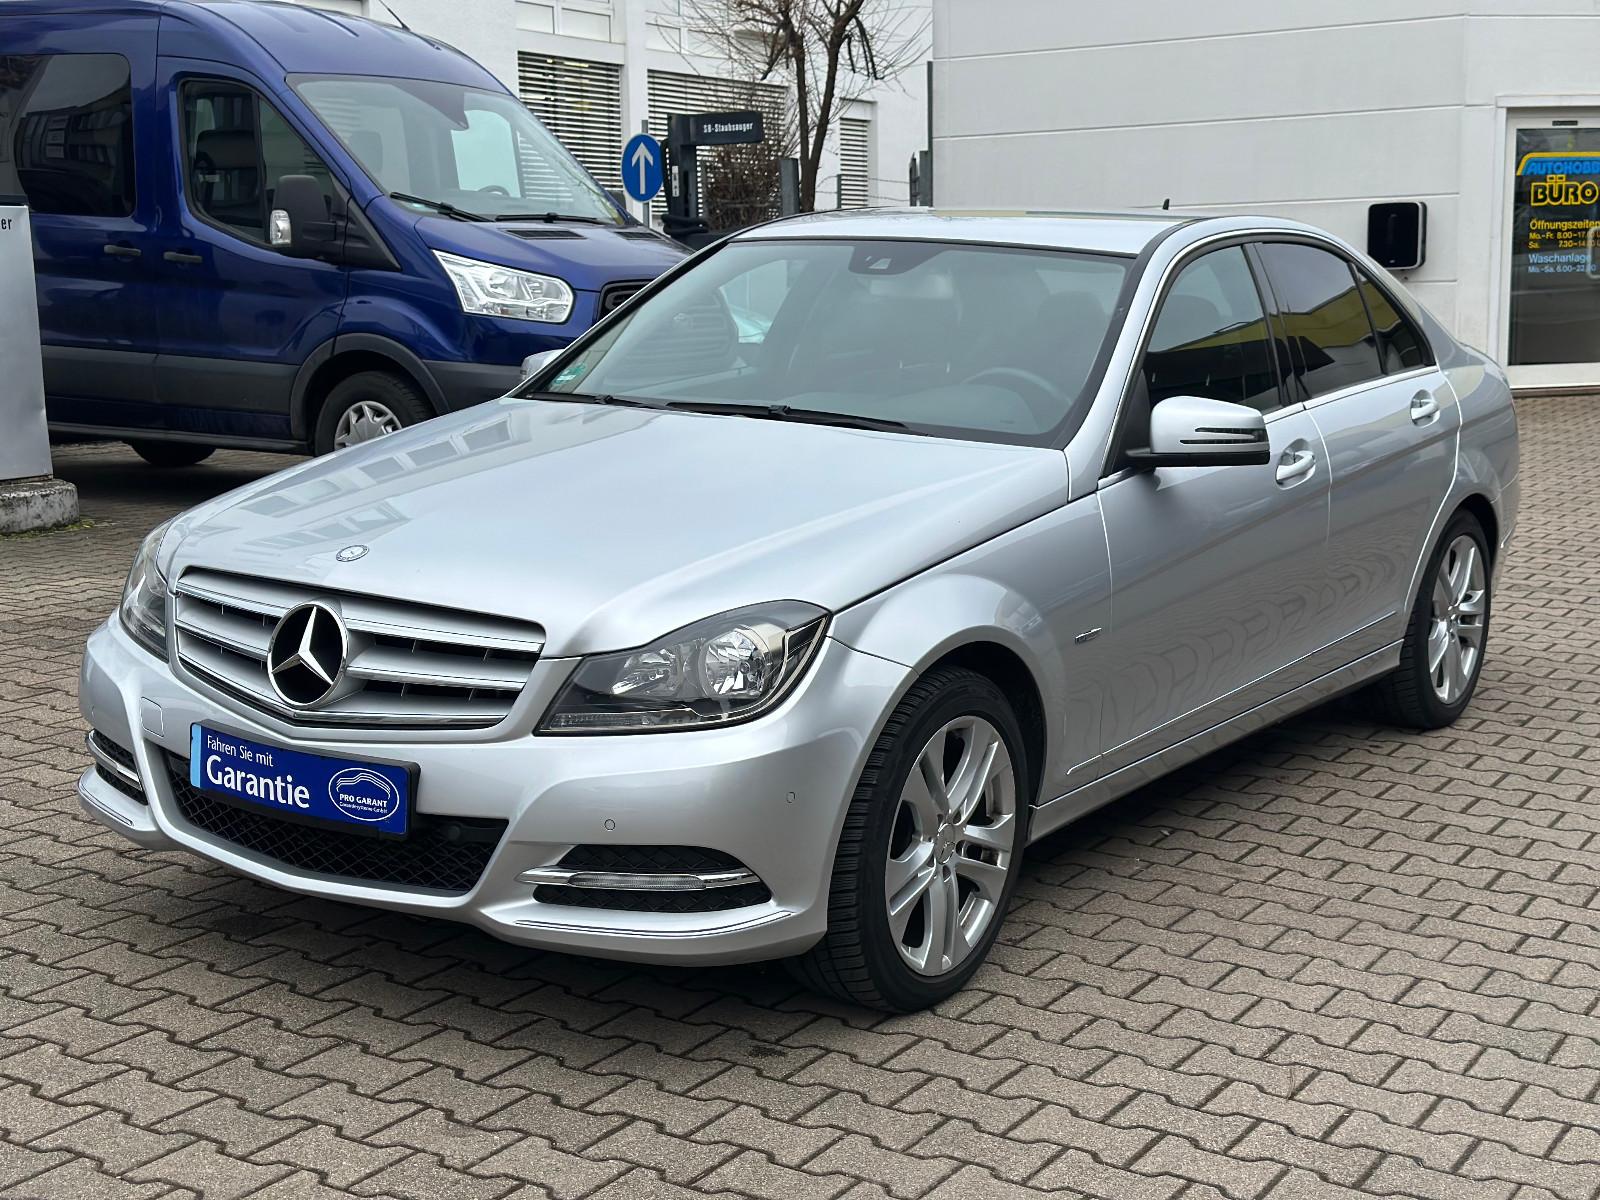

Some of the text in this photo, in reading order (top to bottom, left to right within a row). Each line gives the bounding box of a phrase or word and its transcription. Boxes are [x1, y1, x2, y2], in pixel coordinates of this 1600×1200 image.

[703, 122, 754, 133] SB-Staubsauger
[1530, 174, 1599, 206] BÜRO
[207, 734, 274, 767] Fahren Sie mit
[206, 754, 310, 809] Garantie
[339, 793, 388, 808] PRO GARANT
